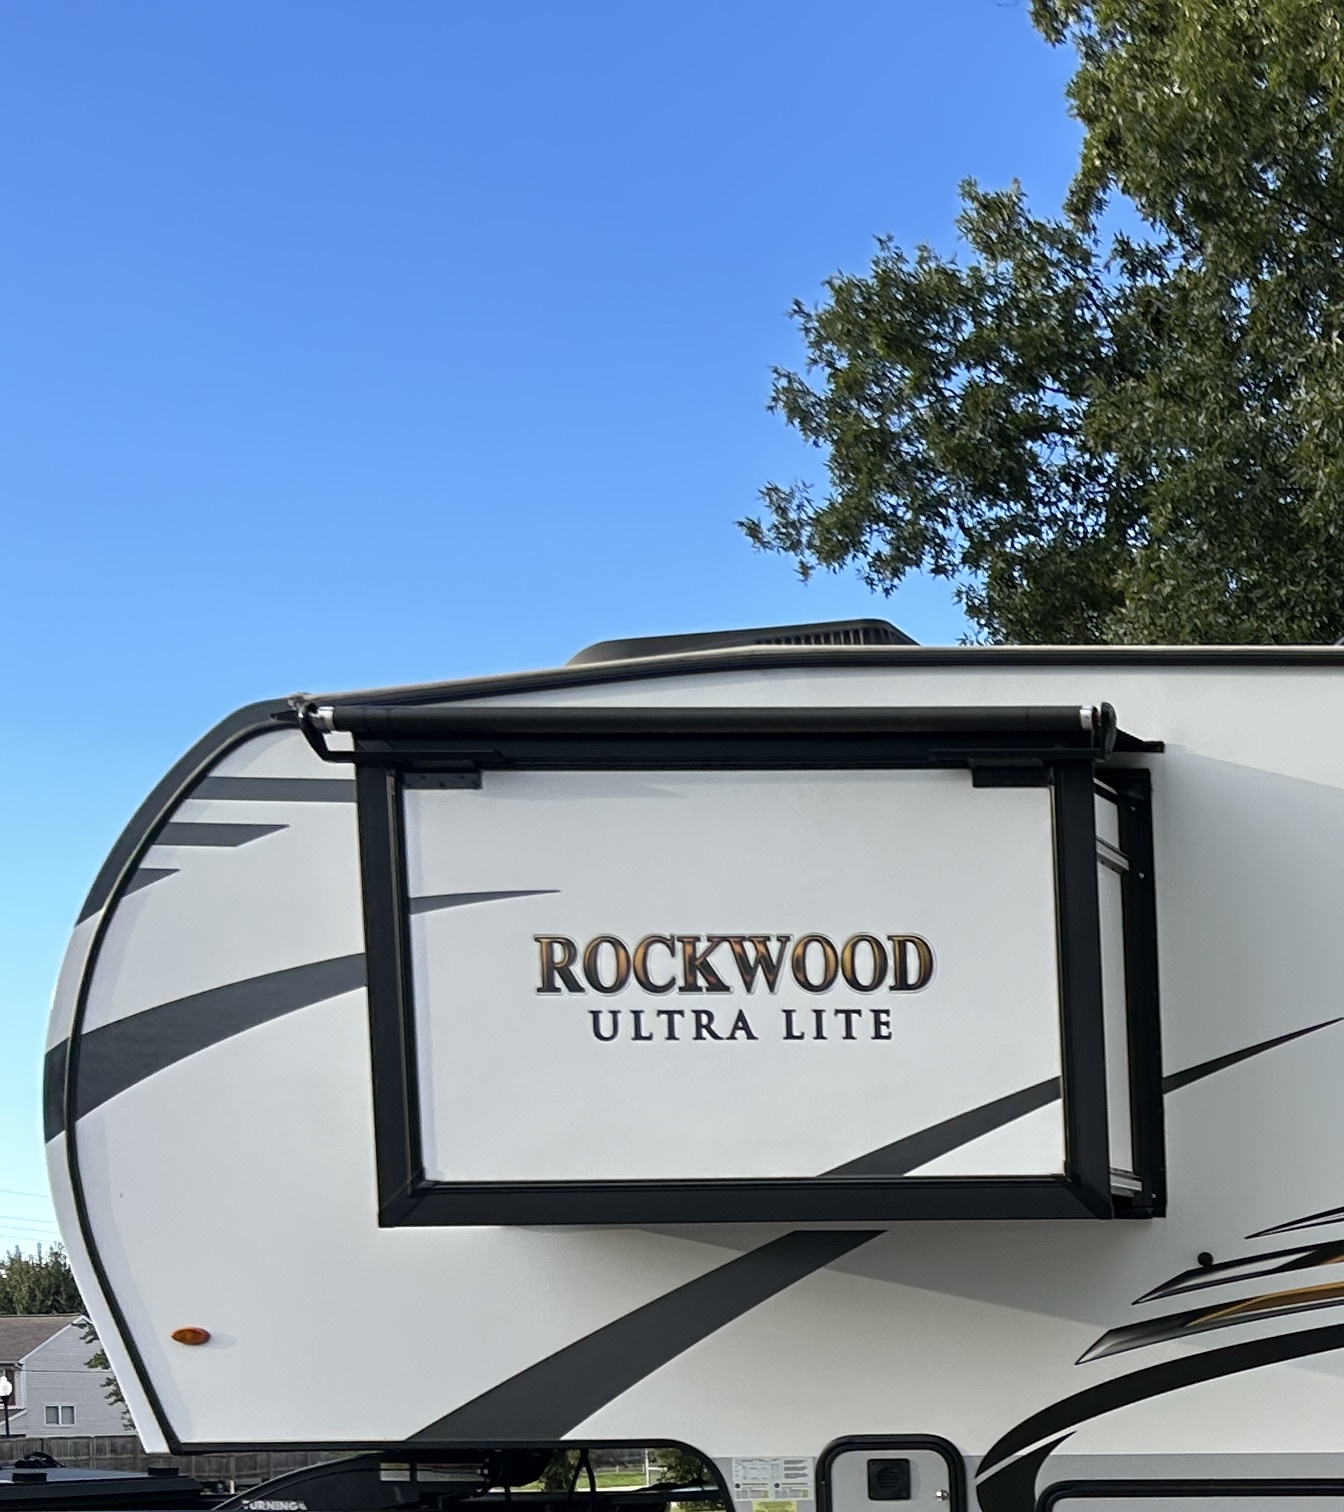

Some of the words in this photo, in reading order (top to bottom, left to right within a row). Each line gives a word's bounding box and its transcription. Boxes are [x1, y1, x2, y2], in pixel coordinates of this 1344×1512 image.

[533, 932, 936, 995] ROCKWOOD
[588, 1009, 760, 1041] ULTRA
[782, 1008, 893, 1041] LITE
